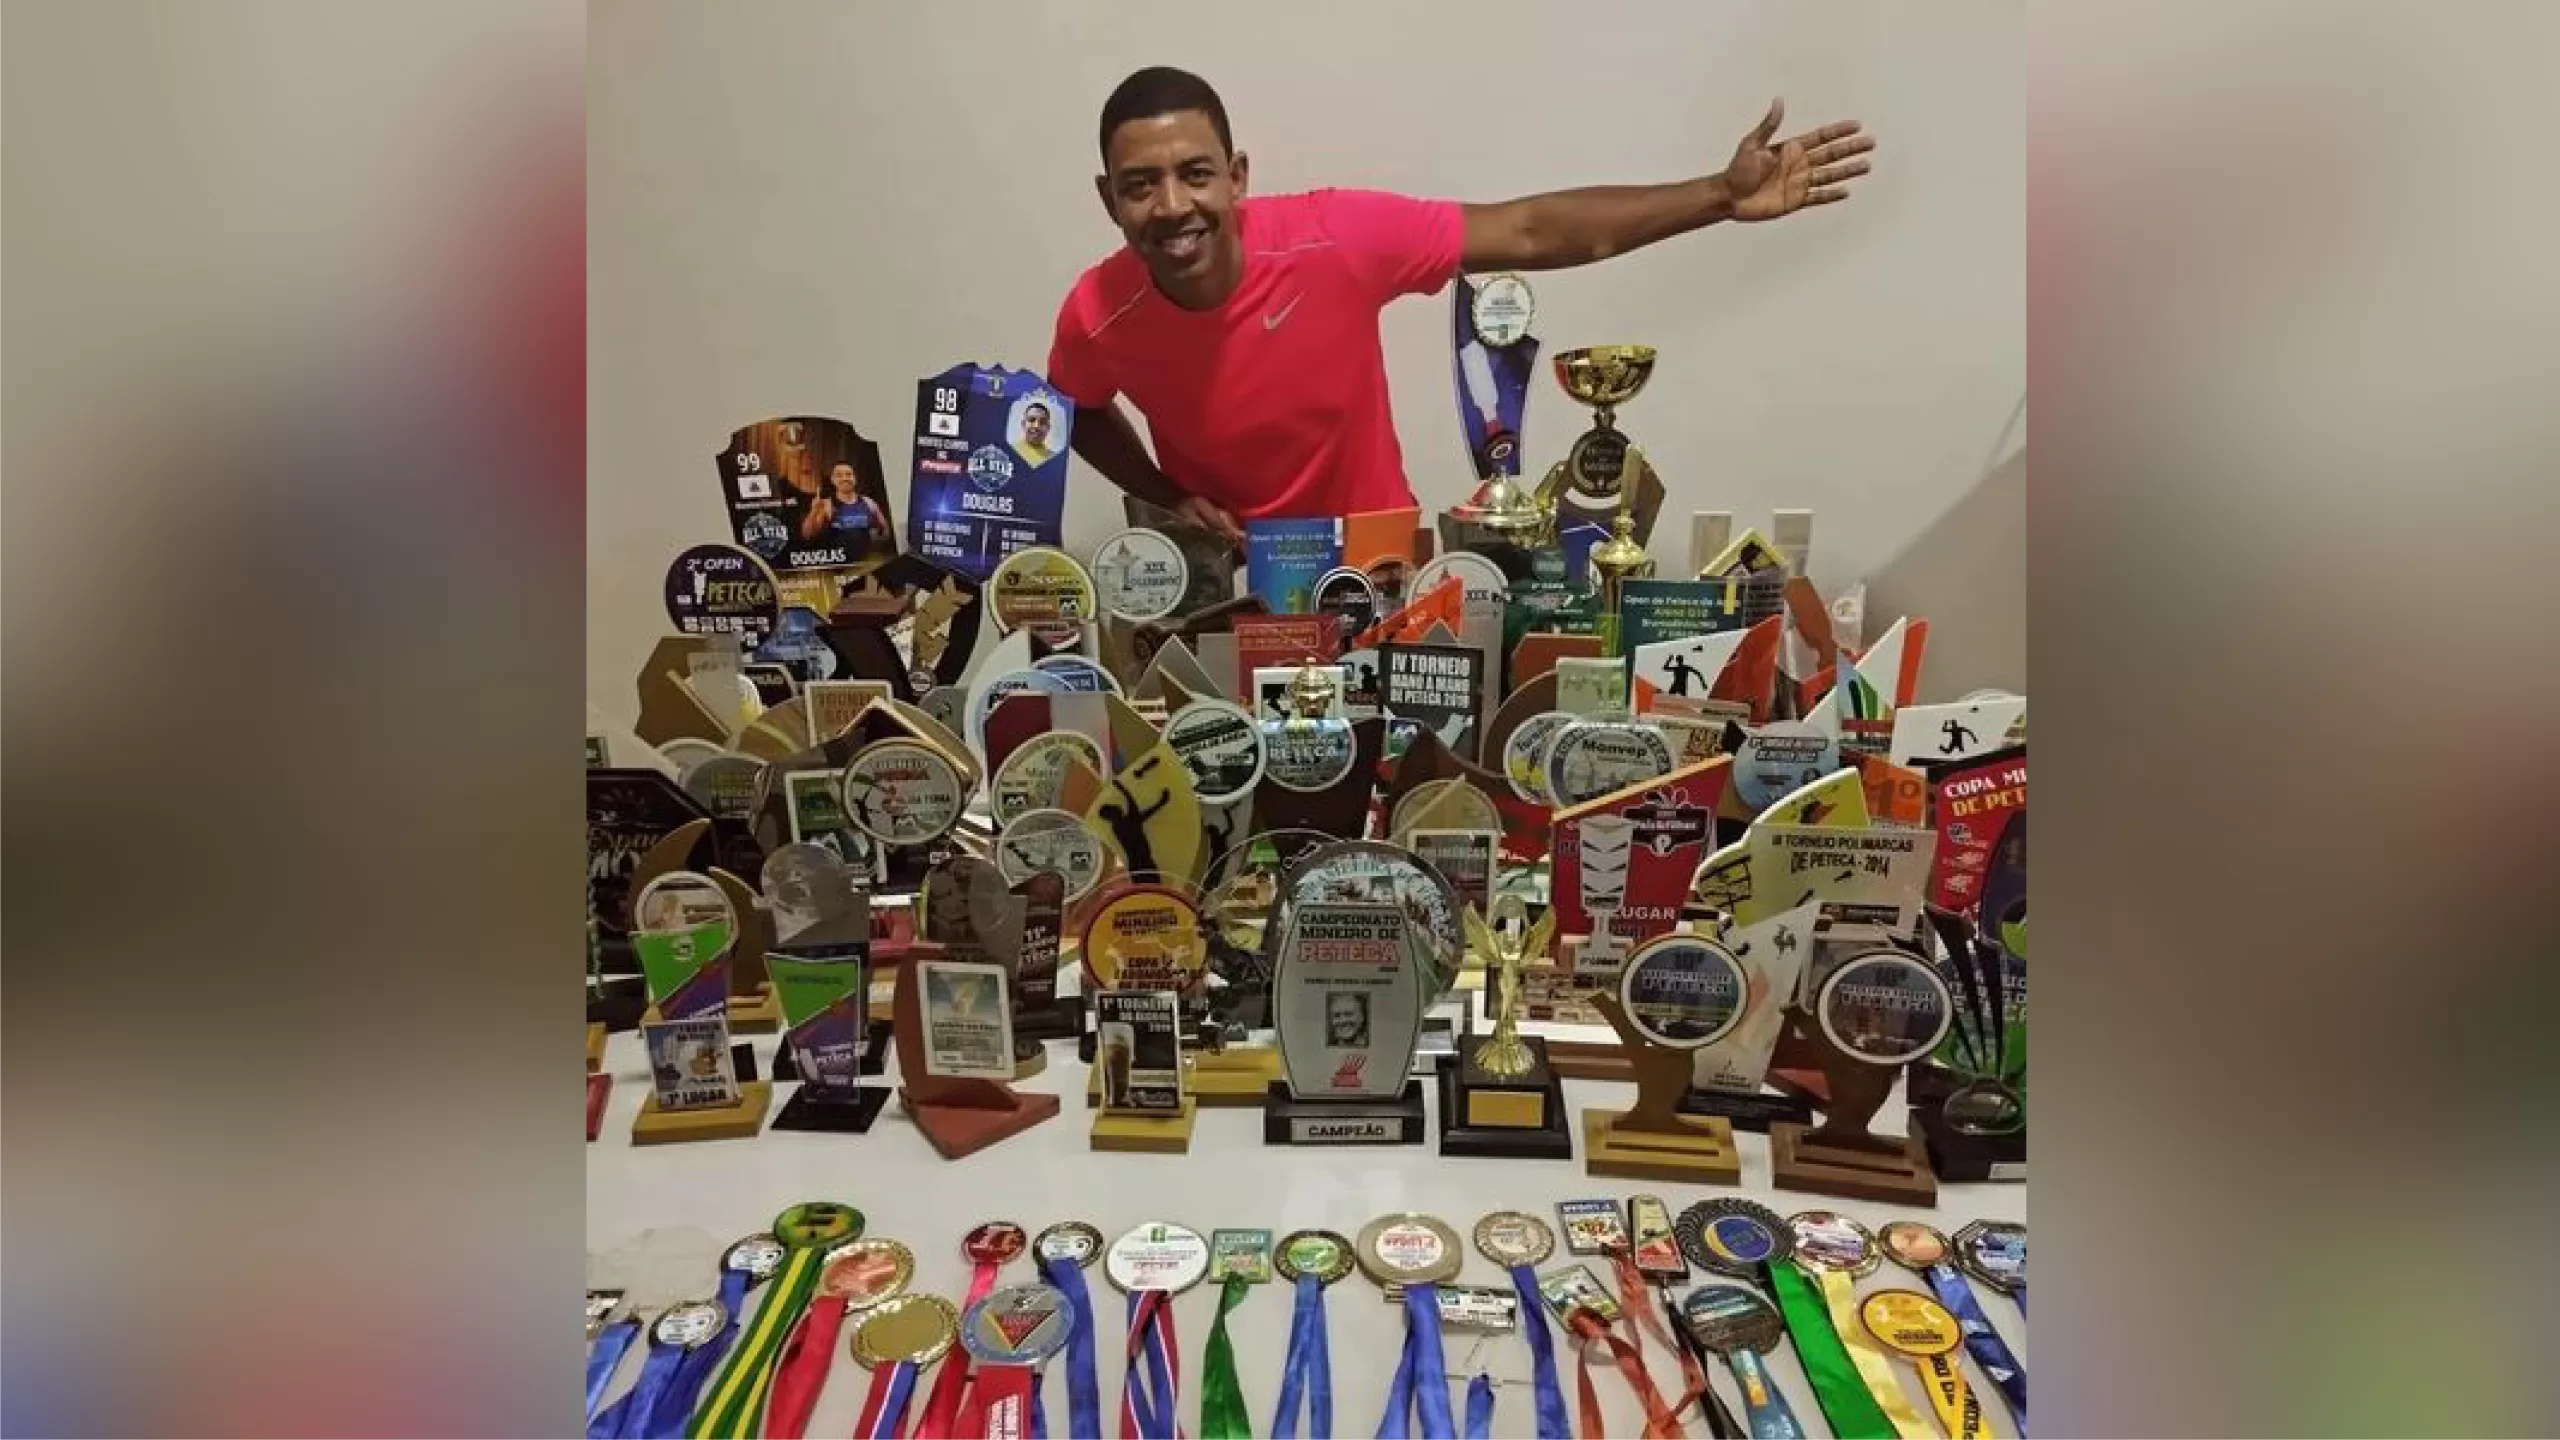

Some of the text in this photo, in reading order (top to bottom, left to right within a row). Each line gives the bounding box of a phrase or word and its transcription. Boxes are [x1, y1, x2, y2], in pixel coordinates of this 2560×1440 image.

[935, 387, 957, 411] 98
[738, 453, 760, 472] 99
[963, 492, 1013, 513] DOUGLAS
[703, 558, 744, 571] OPEN
[790, 548, 847, 565] DOUGLAS
[708, 581, 770, 605] PETECA
[1392, 653, 1470, 678] IV TORNEIO
[1391, 674, 1425, 689] MANO
[1435, 677, 1470, 692] MANO
[1390, 688, 1402, 702] DE
[1404, 690, 1441, 706] PETECA
[1582, 739, 1648, 758] Monvep
[1944, 776, 1996, 799] COPA
[1951, 797, 1980, 817] DE
[1785, 834, 1835, 850] TORNEIO
[1838, 836, 1915, 852] POLIMARCAS
[1790, 851, 1808, 874] DE
[1810, 852, 1856, 869] PETECA
[1864, 853, 1892, 878] 2014
[1300, 912, 1401, 926] CAMPEONATO
[1300, 926, 1401, 941] MINEIRO DE
[1298, 940, 1401, 963] PETECA
[1307, 1123, 1387, 1138] CAMPEÃO
